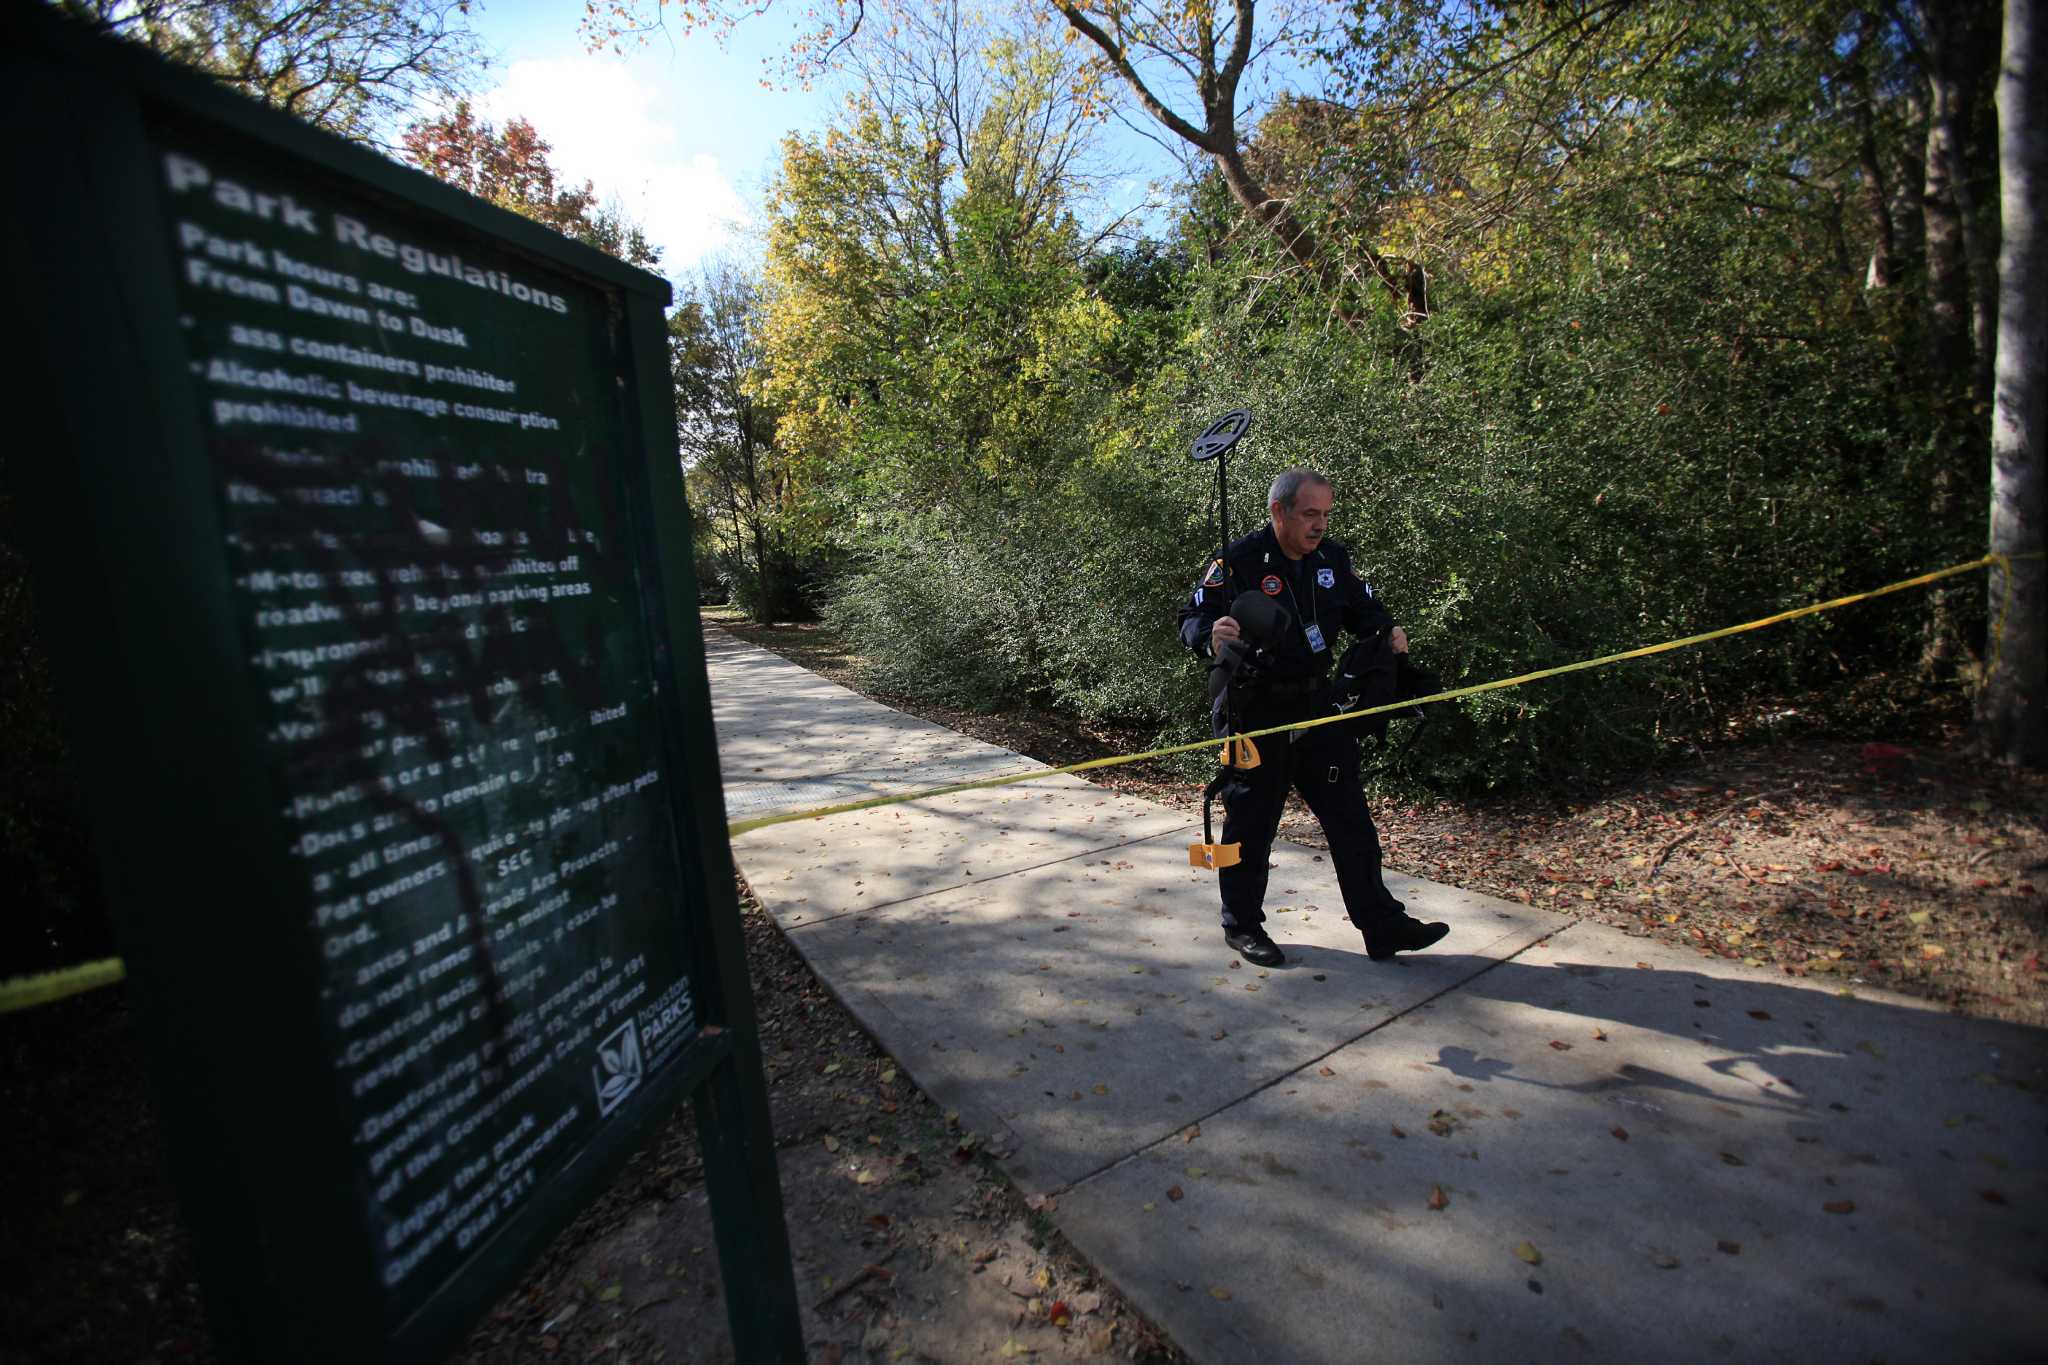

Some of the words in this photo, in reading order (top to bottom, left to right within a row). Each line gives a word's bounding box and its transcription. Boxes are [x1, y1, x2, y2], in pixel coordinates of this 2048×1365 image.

[164, 152, 319, 236] Park
[333, 212, 568, 314] Regulations
[177, 221, 269, 271] Park
[272, 249, 361, 294] hours
[367, 281, 419, 310] are:
[185, 257, 280, 303] From
[287, 284, 371, 325] Dawn
[375, 308, 405, 333] to
[410, 315, 469, 348] Dusk
[220, 318, 284, 351] ass
[288, 336, 420, 377] containers
[212, 399, 360, 434] prohibited
[347, 378, 448, 418] beverage
[559, 554, 580, 573] off
[489, 584, 549, 605] parking
[552, 581, 592, 598] areas
[427, 755, 465, 777] ue
[442, 773, 506, 808] remain
[315, 896, 361, 928] Pet
[366, 859, 447, 907] owners
[413, 920, 452, 957] and
[560, 839, 622, 880] Protecte
[376, 974, 417, 1008] not
[641, 991, 692, 1049] PARKS
